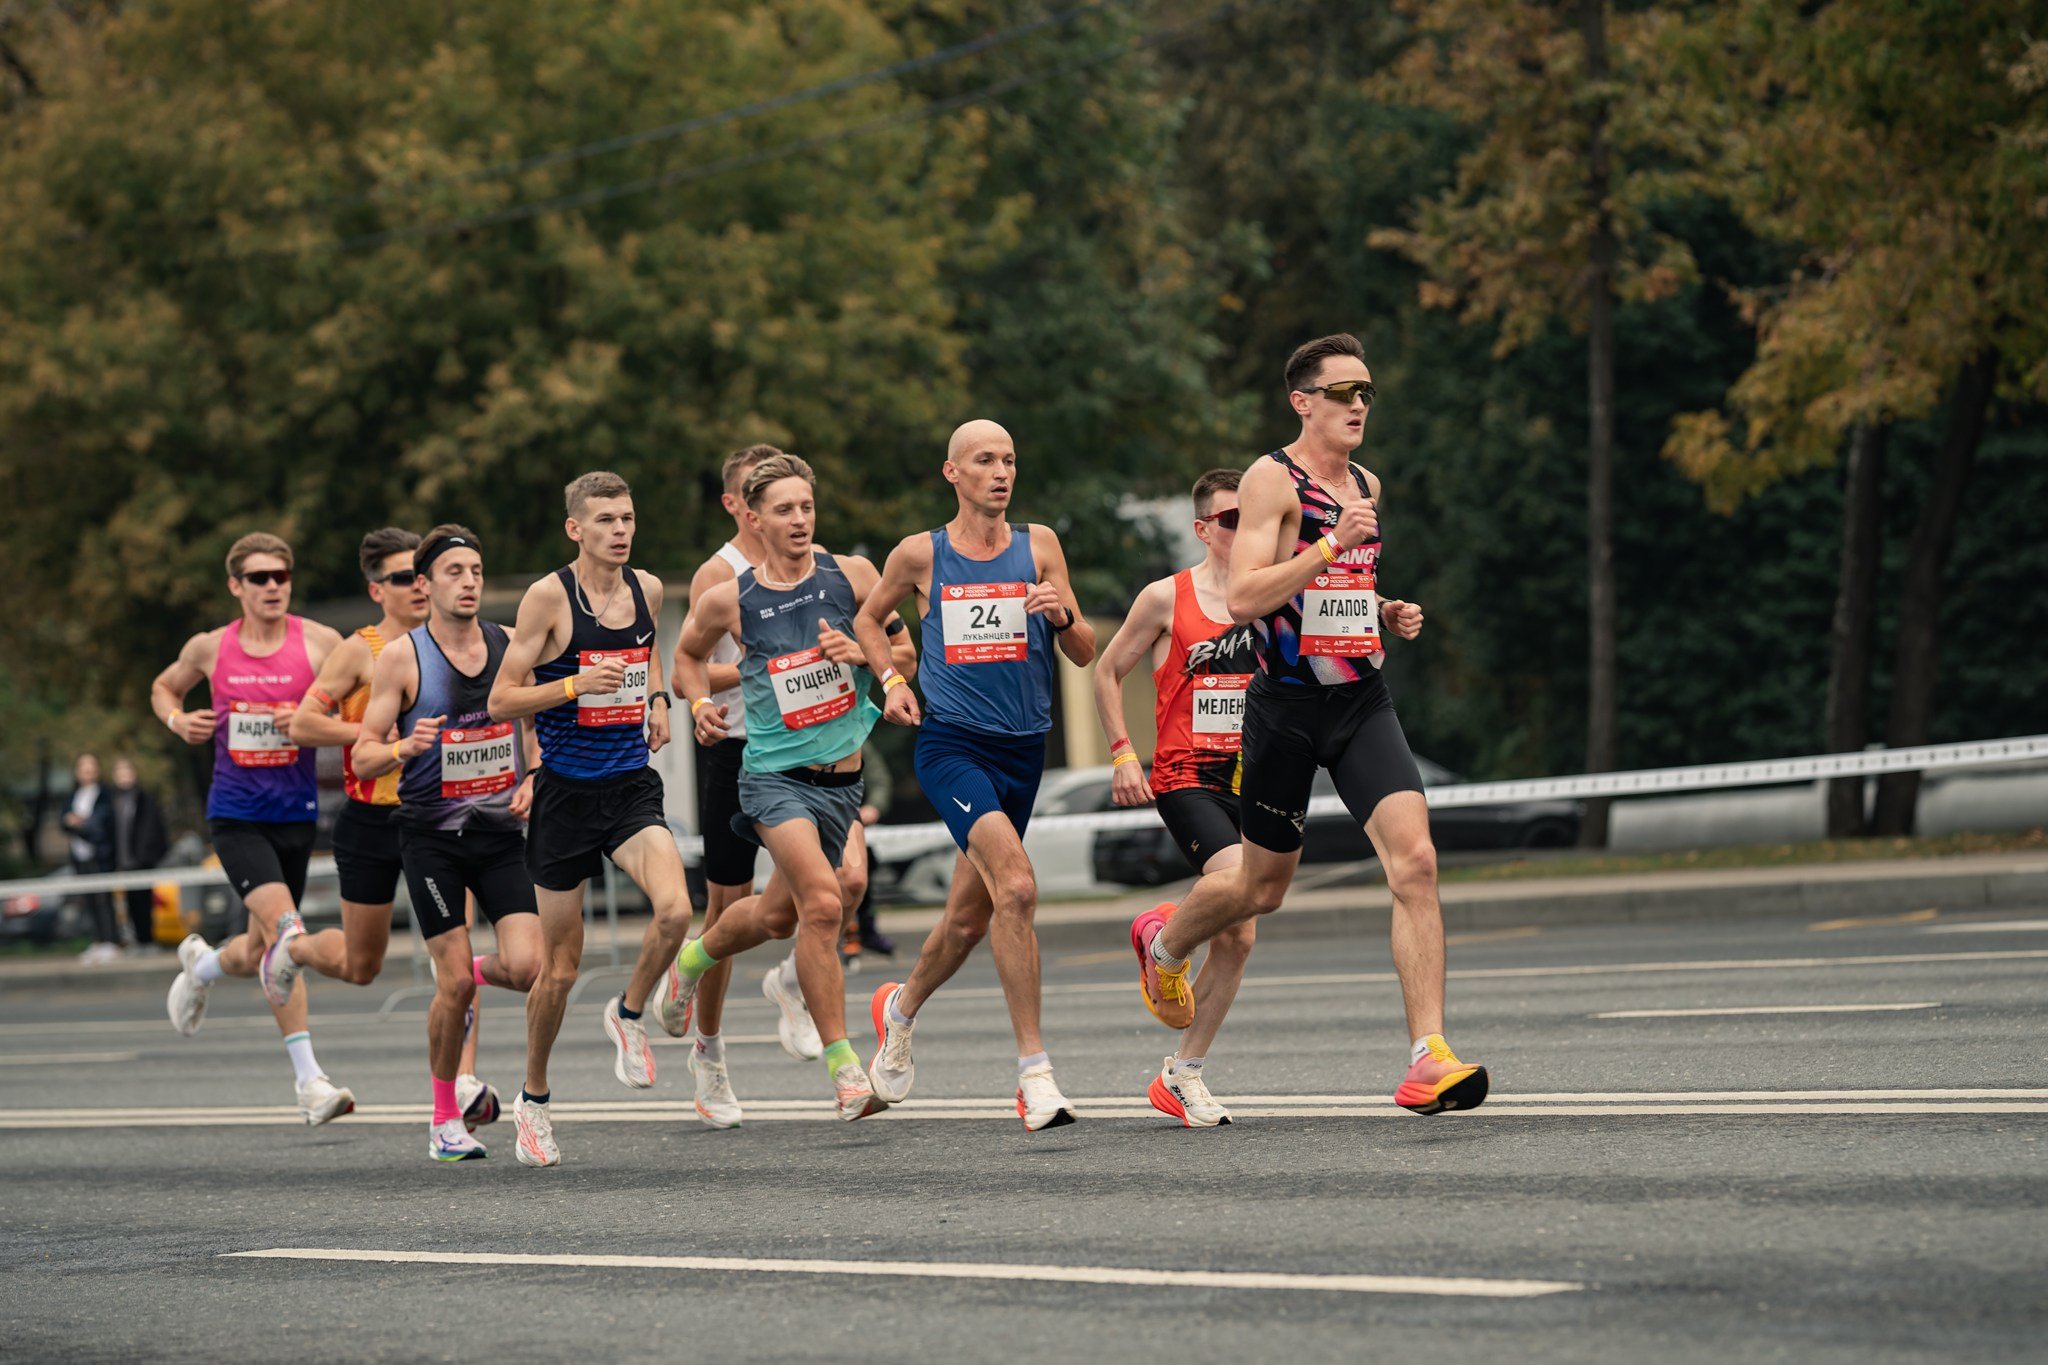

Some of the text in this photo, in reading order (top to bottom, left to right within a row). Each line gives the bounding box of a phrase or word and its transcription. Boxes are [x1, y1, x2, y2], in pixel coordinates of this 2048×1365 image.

[1336, 547, 1375, 565] ANG
[970, 605, 1001, 629] 24
[1319, 599, 1368, 617] АГАПОВ
[962, 632, 1011, 642] ЛУКЬЯНЦЕВ
[785, 664, 842, 694] СУЩЕНЯ
[1198, 698, 1244, 715] МЕЛЕН
[459, 711, 490, 723] ADIXI
[237, 720, 281, 737] АНДРЕ
[447, 743, 512, 766] ЯКУТИЛОВ
